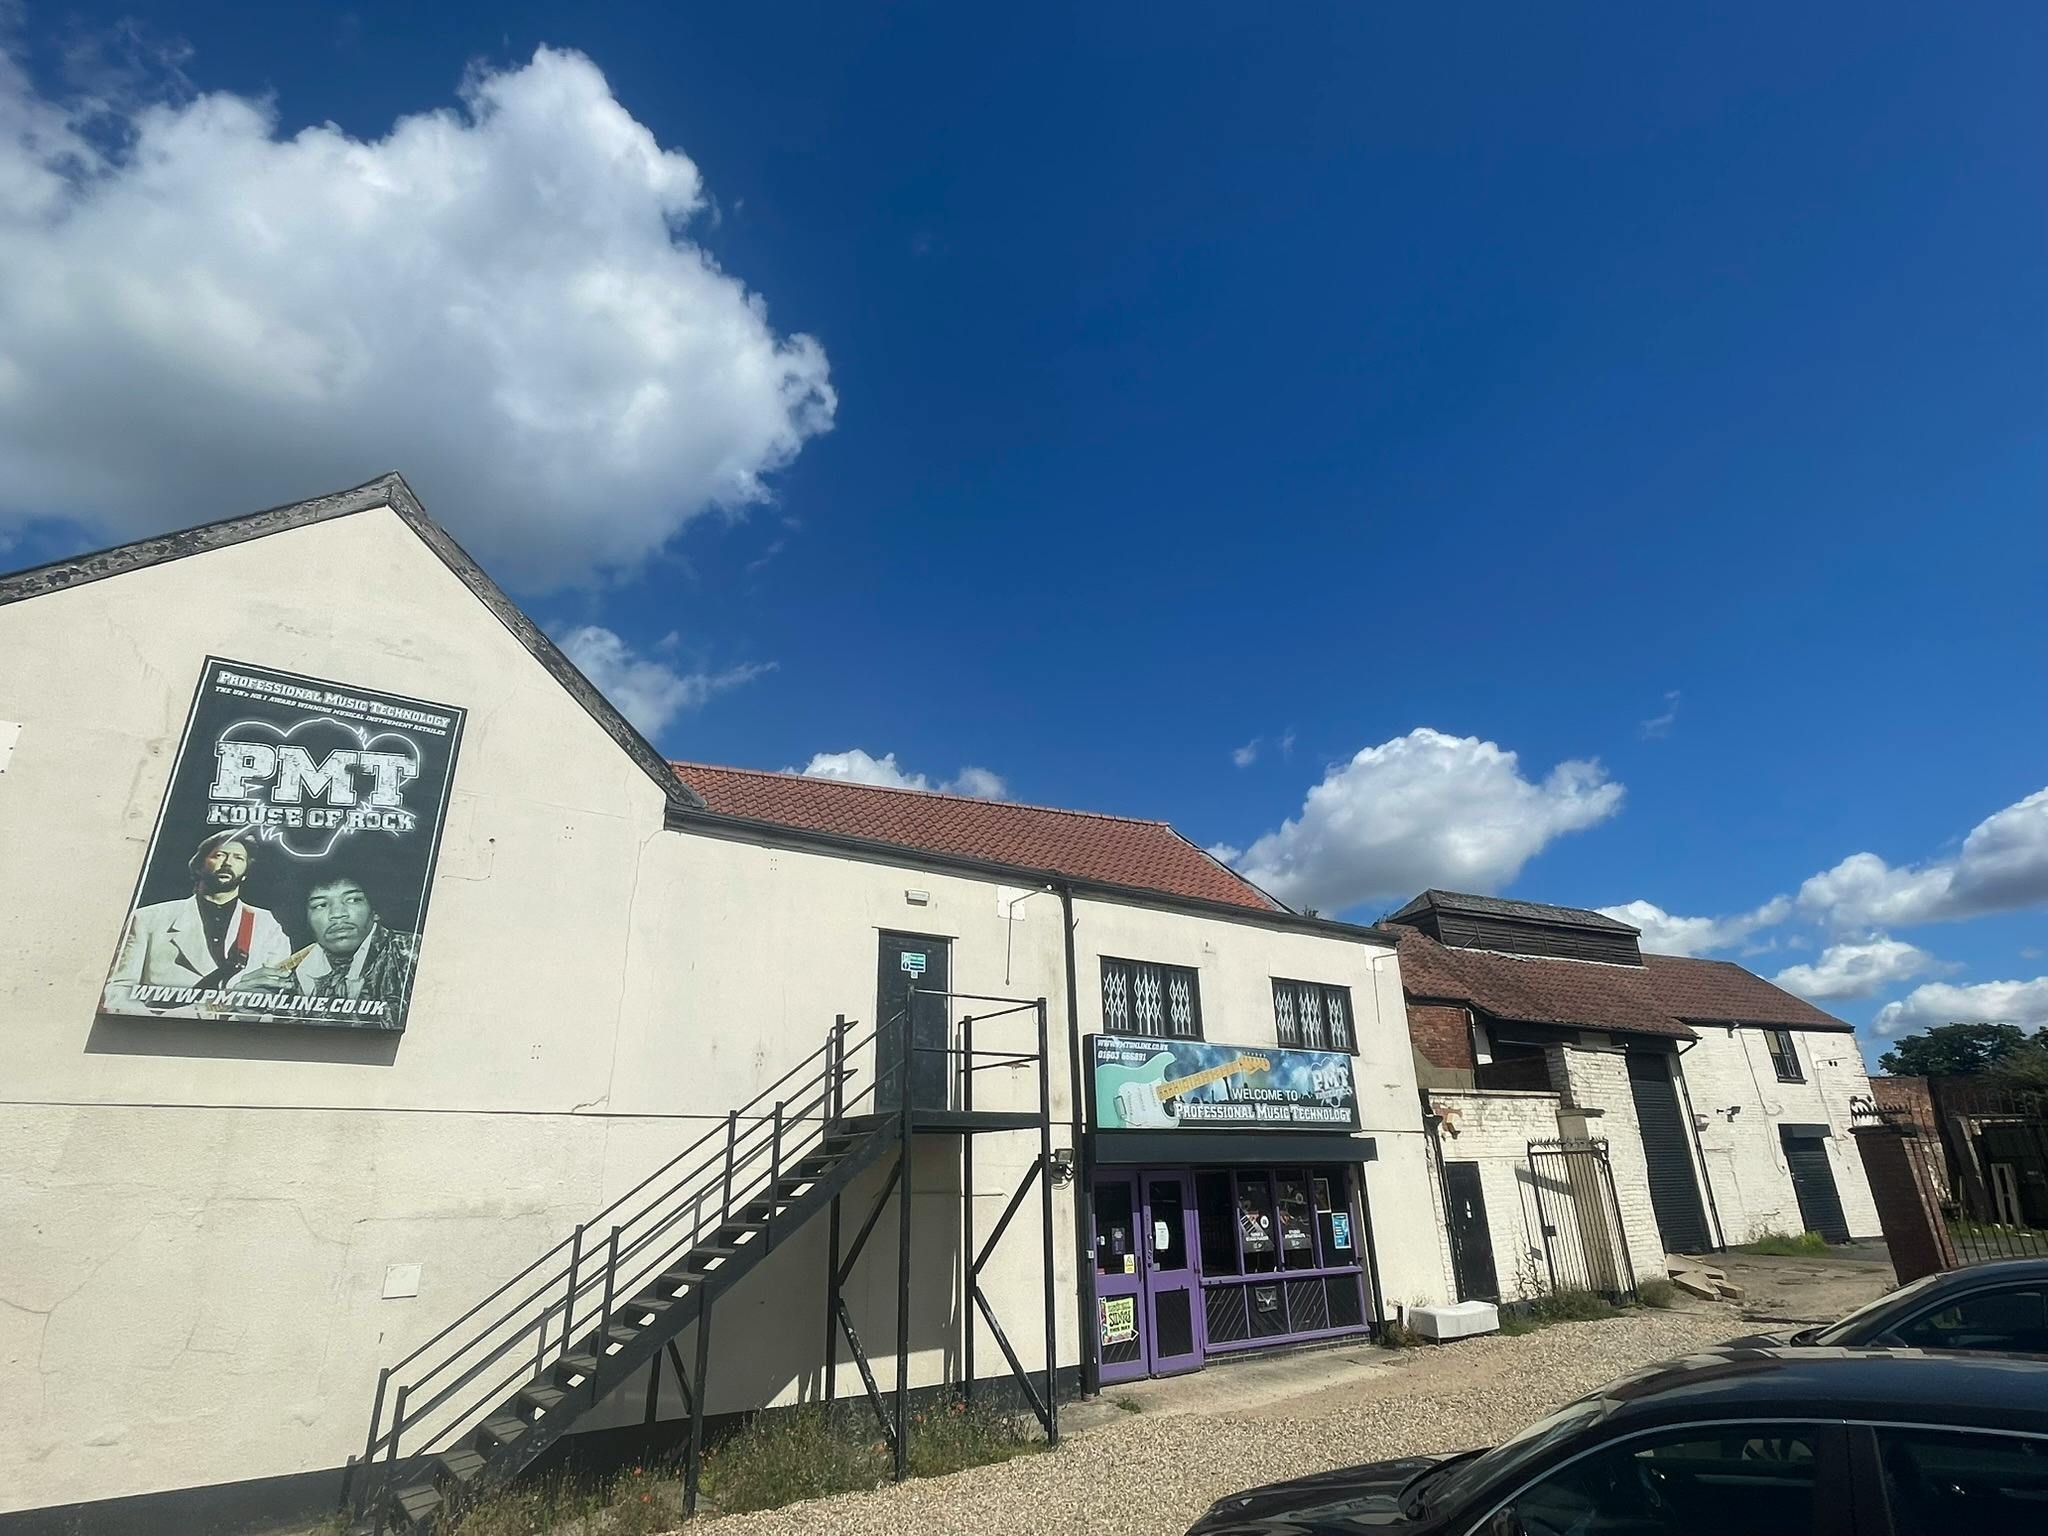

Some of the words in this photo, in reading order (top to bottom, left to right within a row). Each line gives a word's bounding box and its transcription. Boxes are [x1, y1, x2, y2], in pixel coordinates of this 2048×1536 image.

[214, 686, 232, 694] THE
[268, 697, 297, 706] AWARD
[297, 702, 332, 714] WINNING
[332, 709, 364, 720] MUSICAL
[365, 716, 413, 729] INSTRUMENT
[413, 725, 446, 736] RETAILER
[216, 671, 322, 702] PROFESSIONAL
[322, 691, 368, 712] MUSIC
[369, 701, 450, 728] TECHNOLOGY
[209, 741, 419, 806] PMT
[207, 803, 303, 828] HOUSE
[306, 808, 343, 829] OF
[347, 810, 416, 832] ROCK
[129, 984, 387, 1016] WWW.PMTONLINE.CO.UK
[1232, 1088, 1286, 1101] WELCOME
[1286, 1090, 1298, 1101] TO
[1174, 1101, 1255, 1120] PROFESSIONAL
[1255, 1102, 1290, 1121] MUSIC
[1289, 1103, 1351, 1122] TECHNOLOGY
